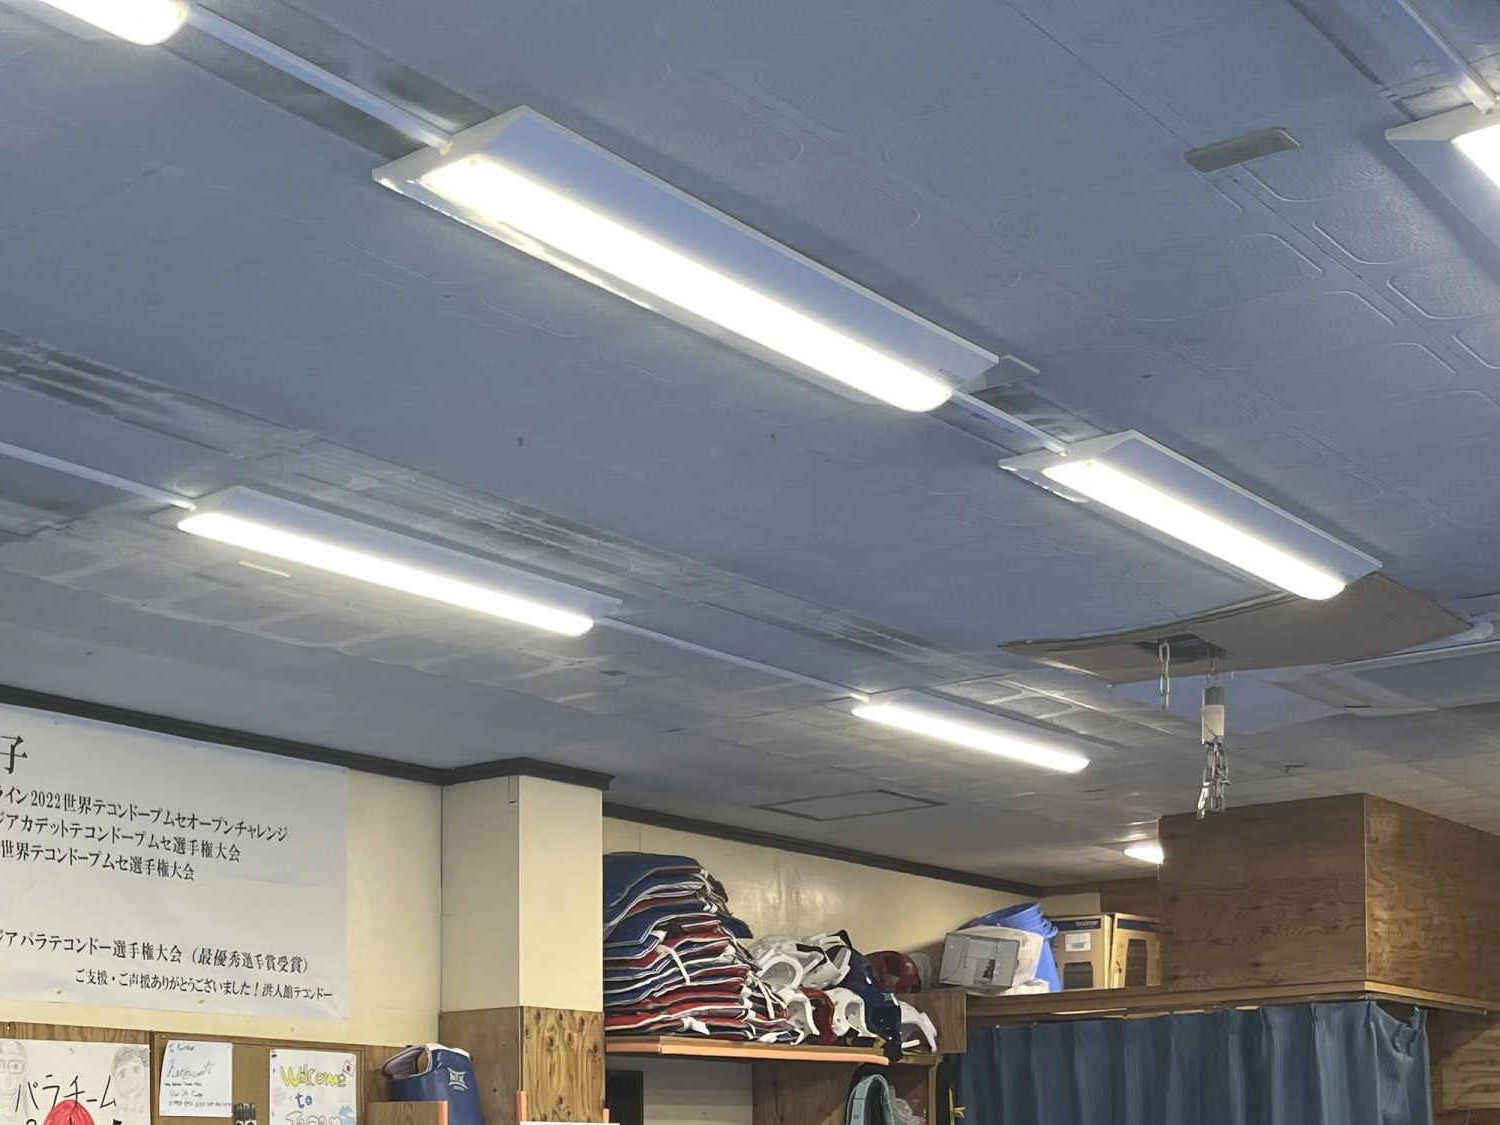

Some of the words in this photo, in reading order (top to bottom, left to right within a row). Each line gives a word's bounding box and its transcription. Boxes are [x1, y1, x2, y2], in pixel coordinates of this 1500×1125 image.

[280, 1064, 347, 1087] Welcome
[15, 1074, 117, 1114] パラチーム
[295, 1092, 313, 1108] to
